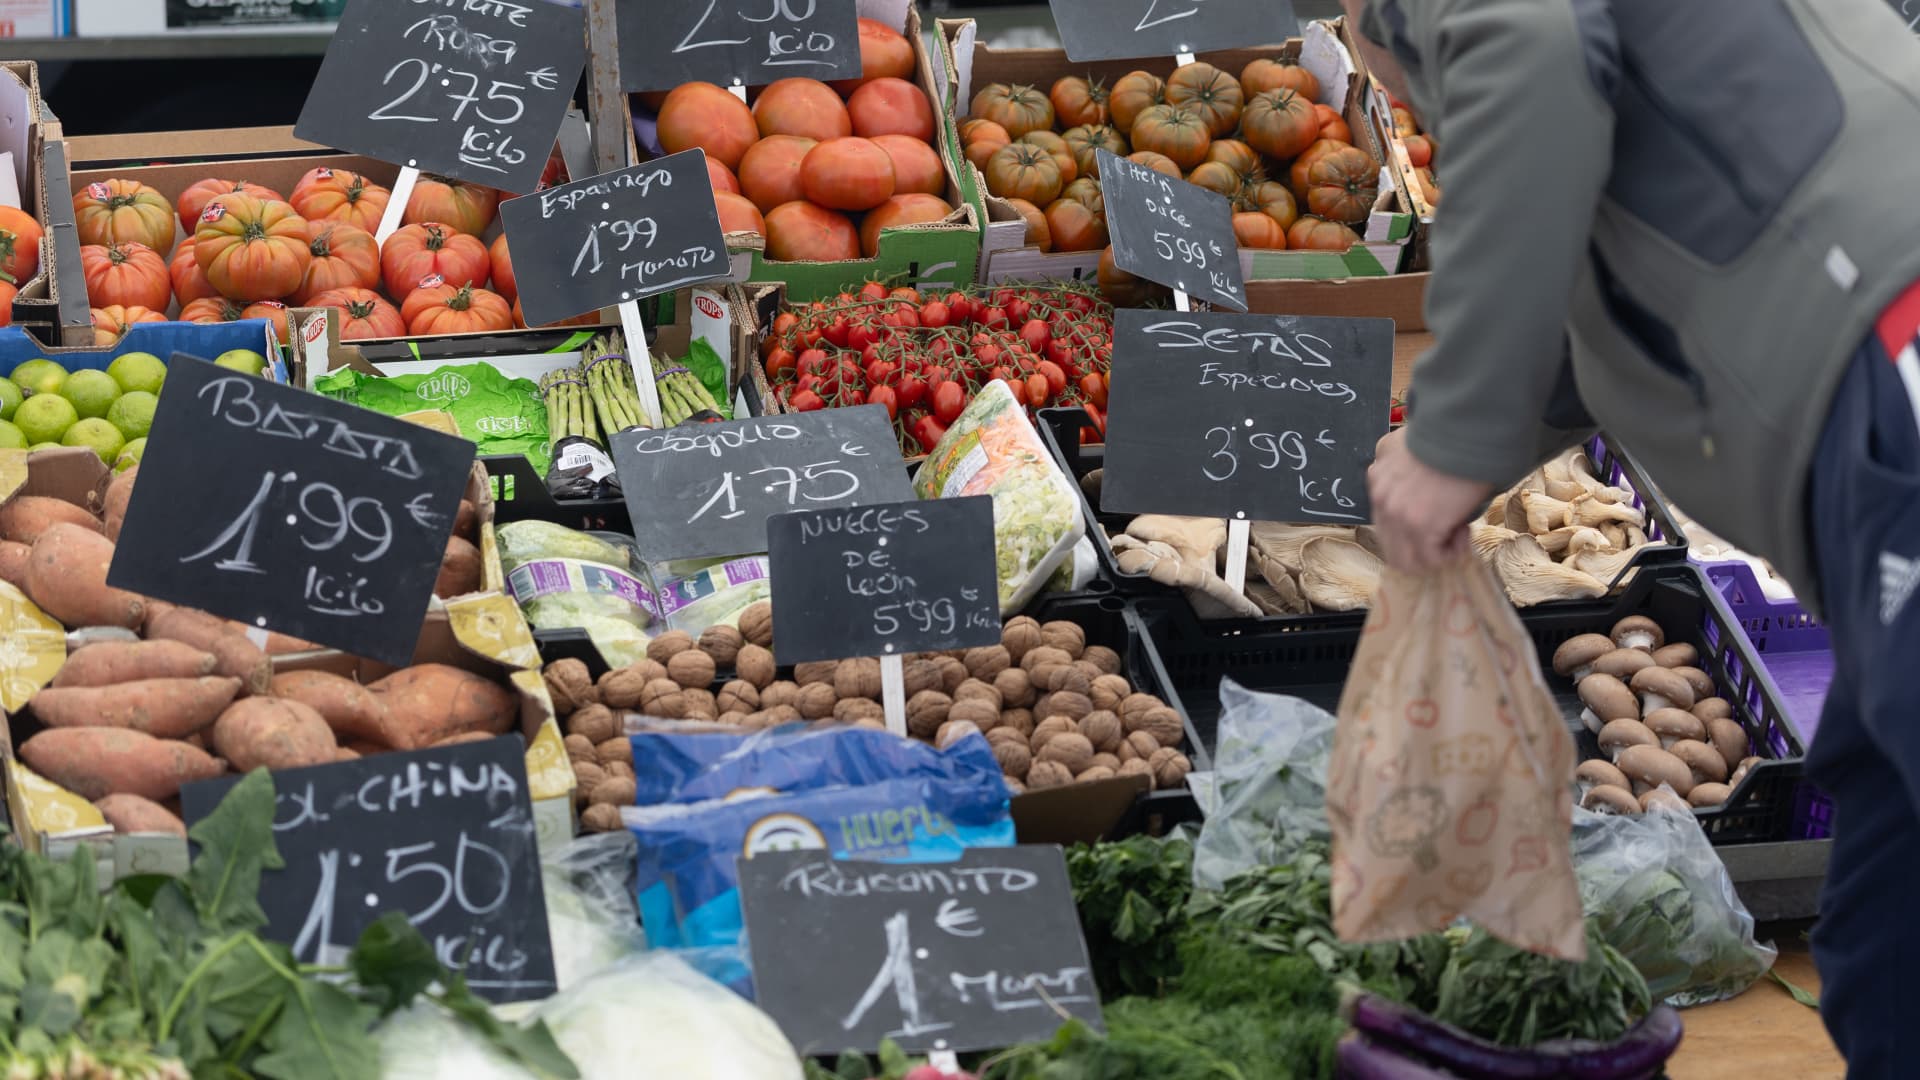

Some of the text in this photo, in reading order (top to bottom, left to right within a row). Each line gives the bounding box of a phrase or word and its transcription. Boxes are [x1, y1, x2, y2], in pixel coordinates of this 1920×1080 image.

[696, 297, 724, 318] TROPS
[1142, 321, 1332, 367] SETAS
[420, 373, 468, 398] TROPS
[801, 509, 929, 544] NUECES
[842, 550, 890, 567] DE
